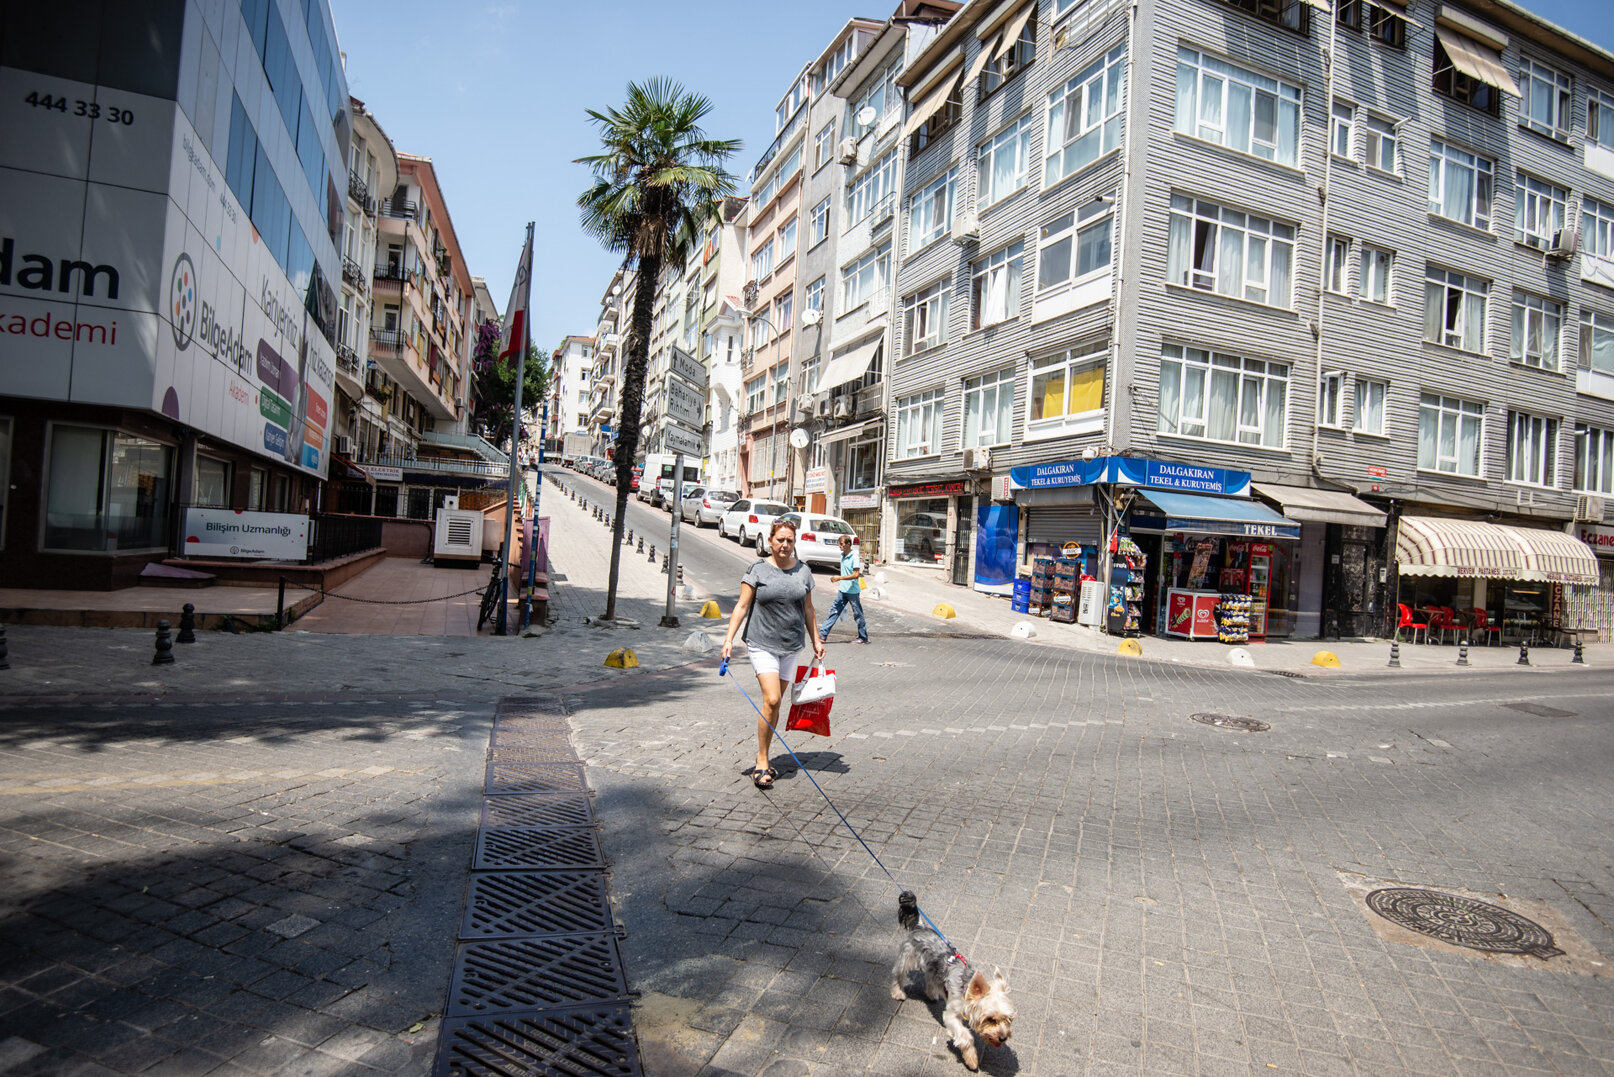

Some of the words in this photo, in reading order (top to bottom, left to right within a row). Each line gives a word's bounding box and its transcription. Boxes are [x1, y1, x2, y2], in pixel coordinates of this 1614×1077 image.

[25, 91, 68, 112] 444
[73, 100, 101, 119] 33
[107, 106, 134, 126] 30
[200, 300, 253, 376] BilgeAdam
[680, 357, 696, 377] Moda
[671, 382, 697, 408] Bahariye
[1036, 464, 1075, 476] DALGAKIRAN
[1160, 464, 1215, 479] DALGAKIRAN
[1031, 478, 1046, 486] TEKEL
[1051, 473, 1081, 485] KURUYEMİŞ
[1150, 475, 1173, 486] TEKEL
[1181, 479, 1222, 493] KURUYEMİŞ
[206, 522, 240, 534] Bilişim
[242, 524, 291, 537] Uzmanlığı
[1243, 523, 1278, 536] TEKEL
[1580, 528, 1614, 547] Eczane
[1553, 582, 1562, 628] CZANE
